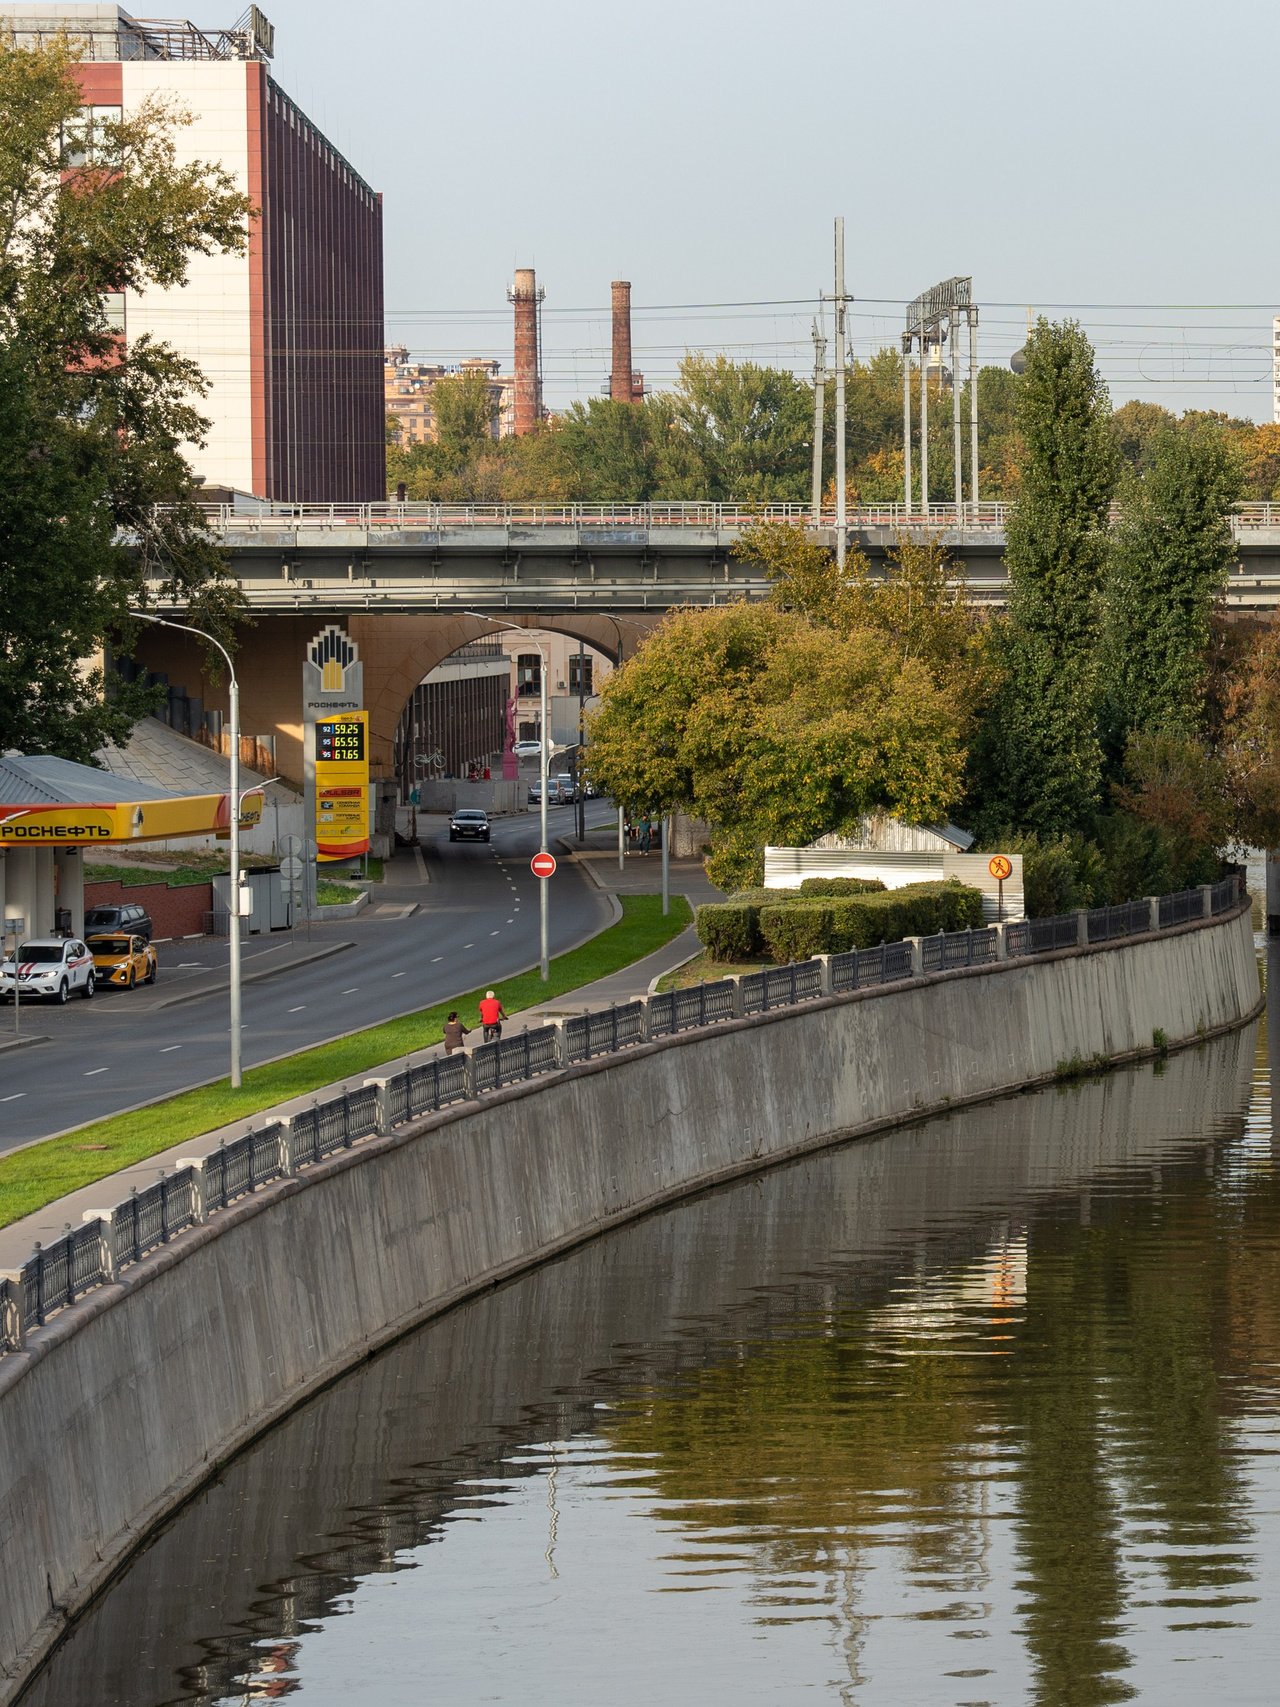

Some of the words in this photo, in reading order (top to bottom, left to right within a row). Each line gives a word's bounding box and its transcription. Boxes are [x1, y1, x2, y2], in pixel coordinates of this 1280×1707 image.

[335, 724, 358, 734] 59.25
[335, 737, 358, 747] 65.55
[335, 750, 358, 759] 67.65
[1, 825, 111, 837] РОСНЕФТЬ
[66, 846, 77, 855] 2
